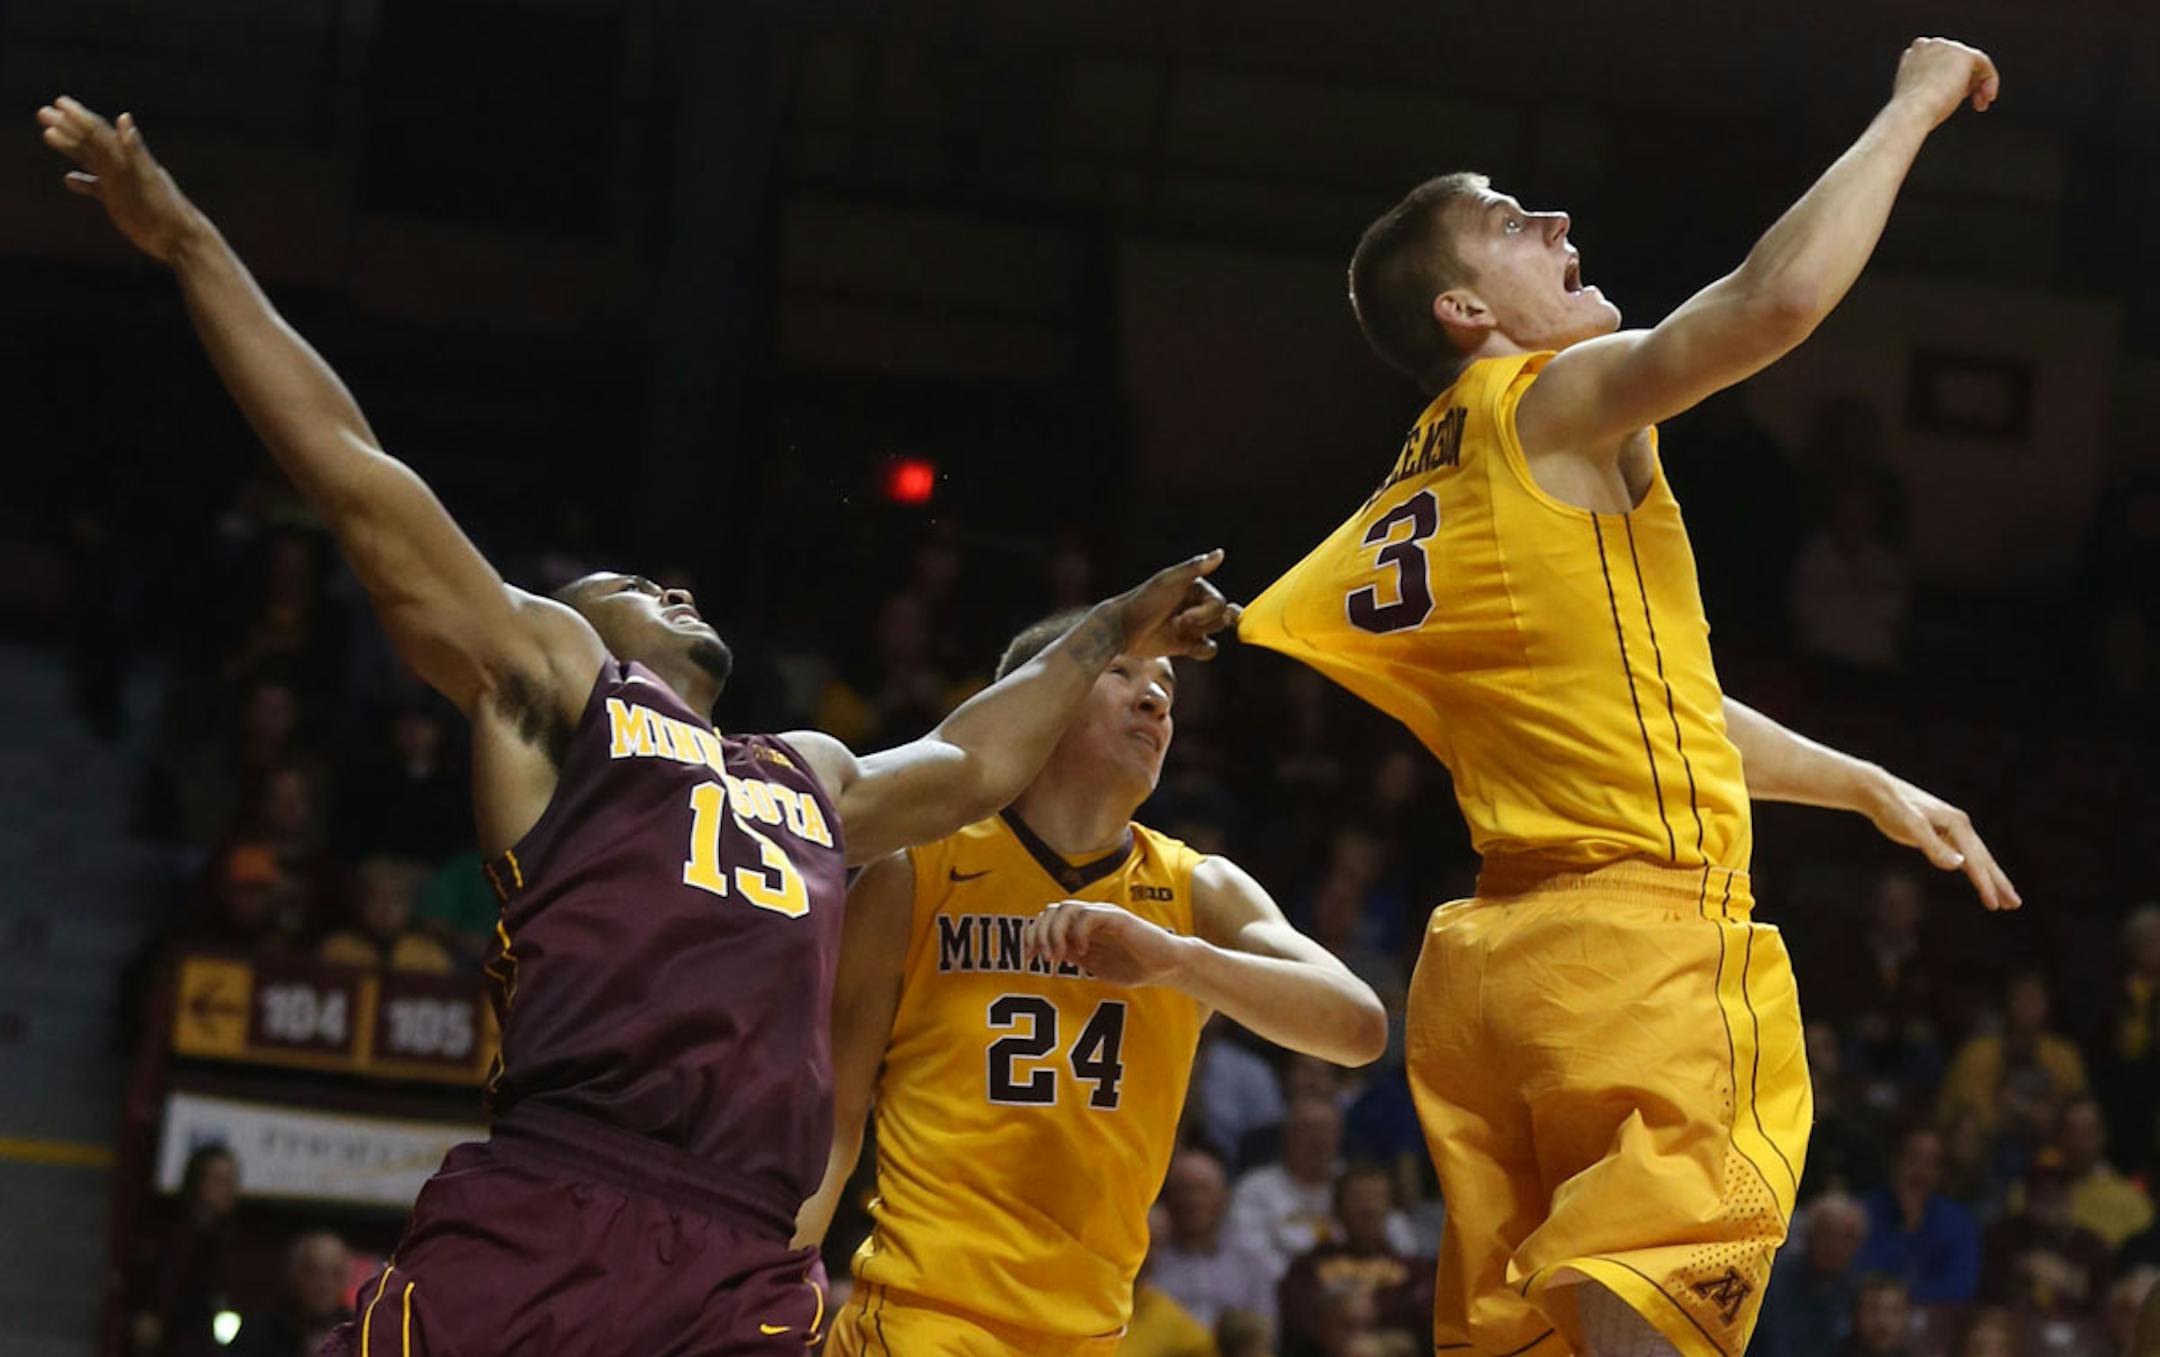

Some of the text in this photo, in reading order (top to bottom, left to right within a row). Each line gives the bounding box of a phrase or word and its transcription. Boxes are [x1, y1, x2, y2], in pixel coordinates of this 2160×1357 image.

[1345, 488, 1440, 635] 3
[605, 697, 834, 849] MINNSOTA
[262, 984, 347, 1045] 104
[388, 1000, 474, 1057] 105
[986, 992, 1128, 1111] 24
